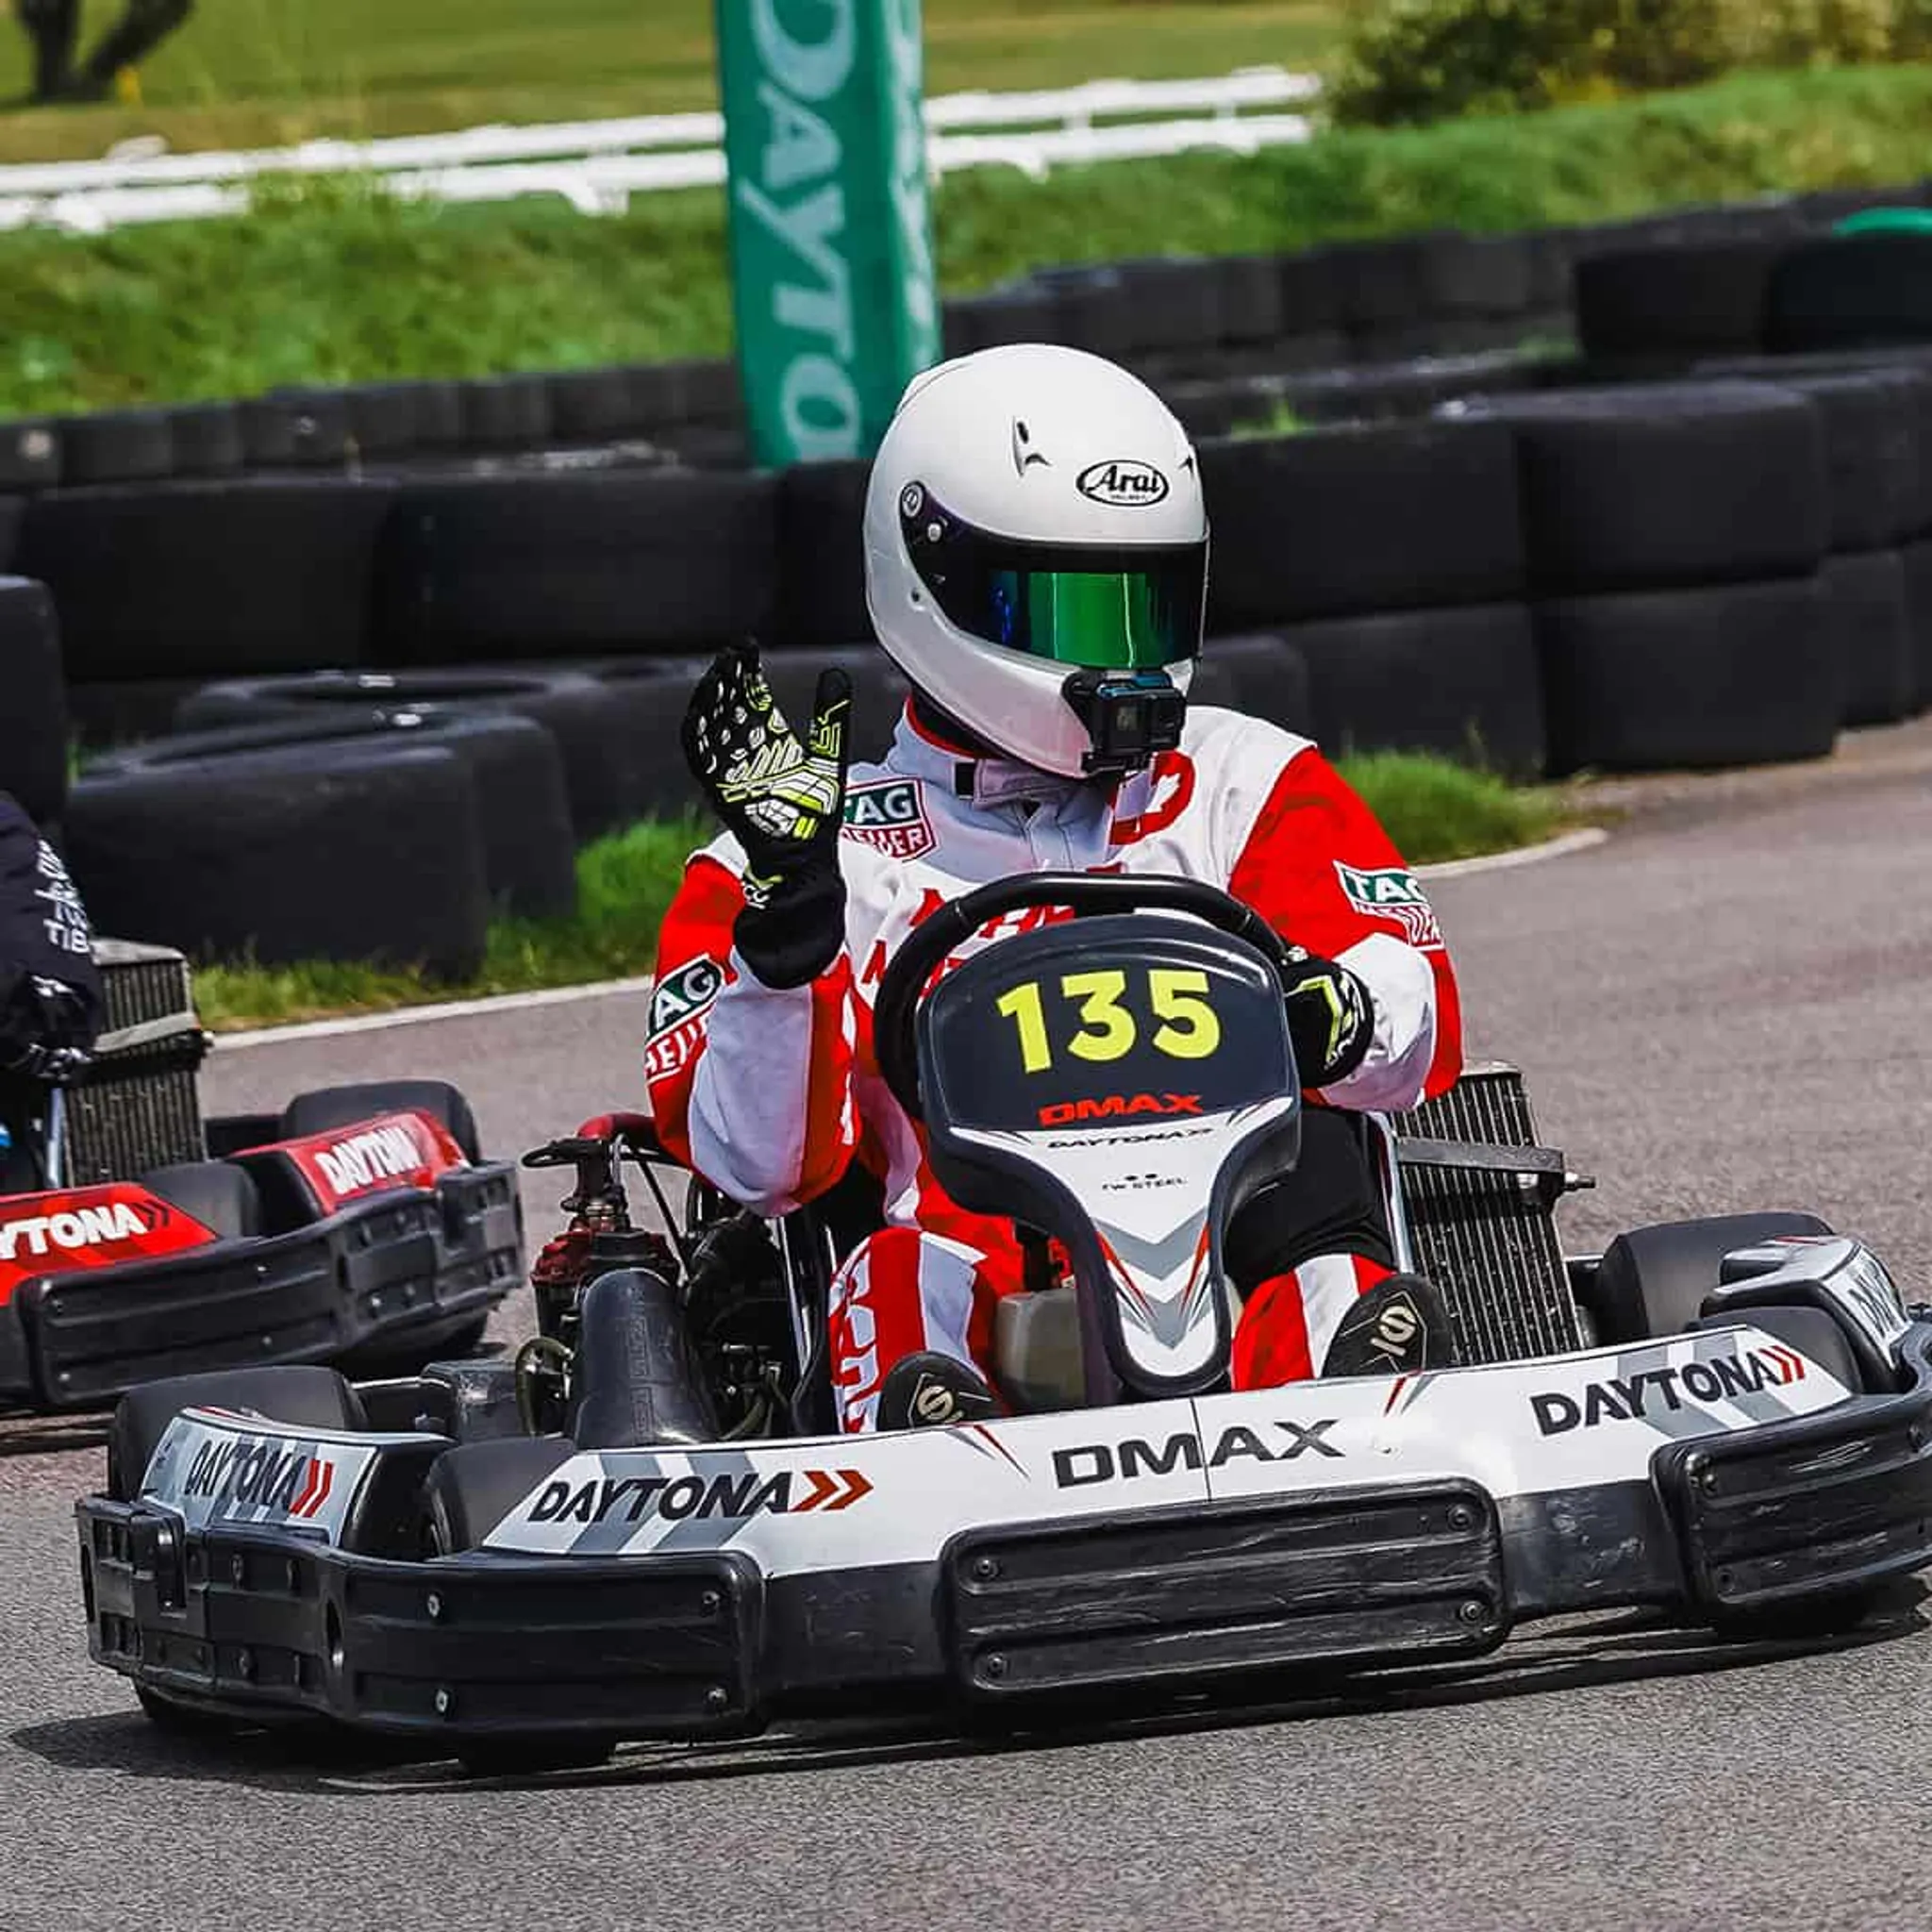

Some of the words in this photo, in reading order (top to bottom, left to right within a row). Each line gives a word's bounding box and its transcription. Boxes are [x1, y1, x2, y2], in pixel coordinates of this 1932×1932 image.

[1086, 464, 1160, 492] Arai
[996, 969, 1221, 1074] 135
[1039, 1092, 1204, 1126] DMAX
[1530, 1351, 1782, 1437] DAYTONA
[184, 1440, 308, 1511] DAYTONA
[1052, 1419, 1346, 1489] DMAX
[528, 1472, 792, 1523] DAYTONA
